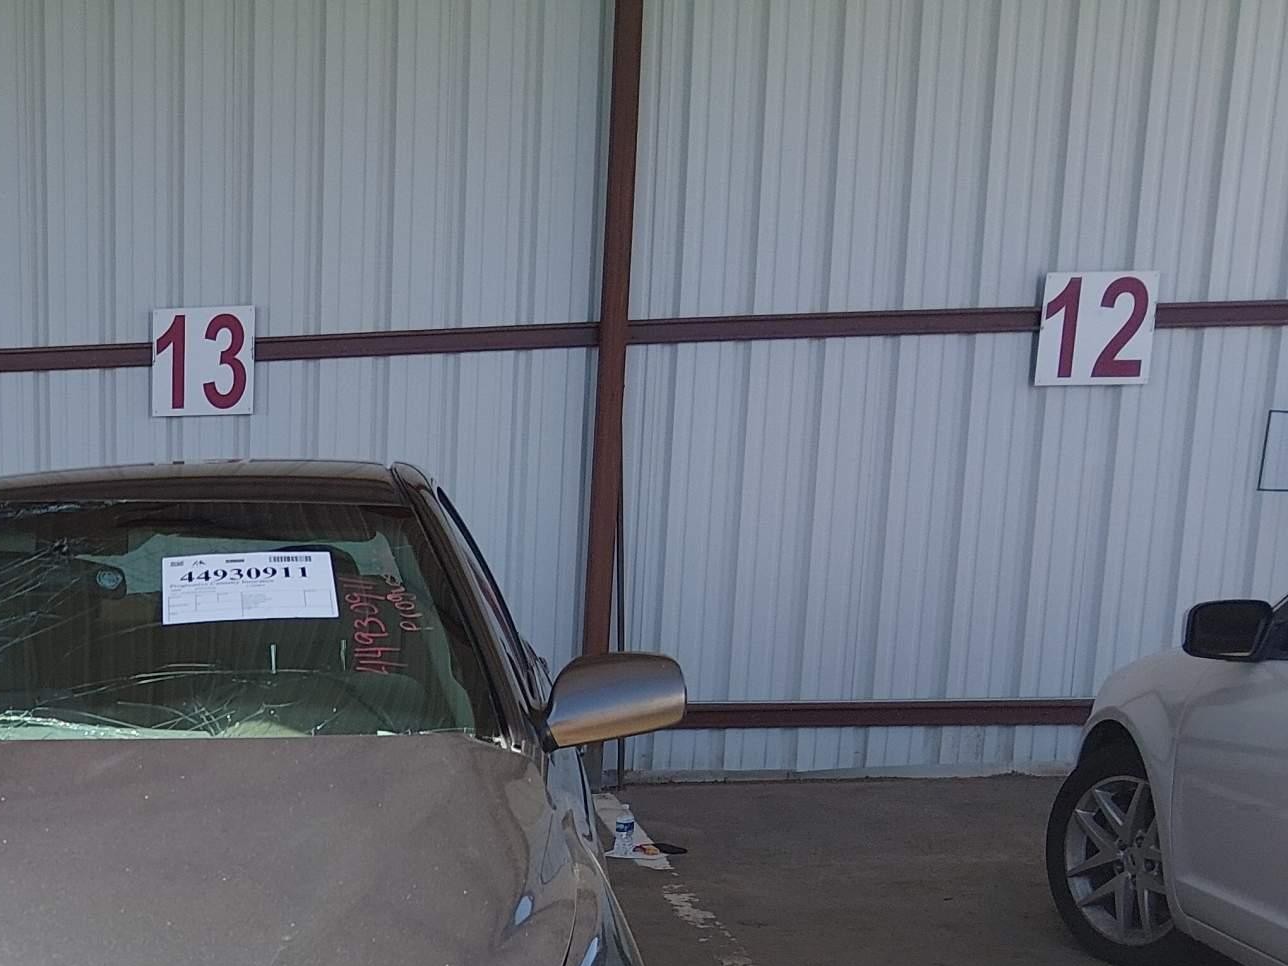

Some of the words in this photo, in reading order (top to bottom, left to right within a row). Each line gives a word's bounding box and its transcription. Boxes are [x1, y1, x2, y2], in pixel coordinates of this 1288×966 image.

[156, 313, 247, 410] 13
[1045, 276, 1149, 378] 12
[179, 566, 309, 583] 44930911
